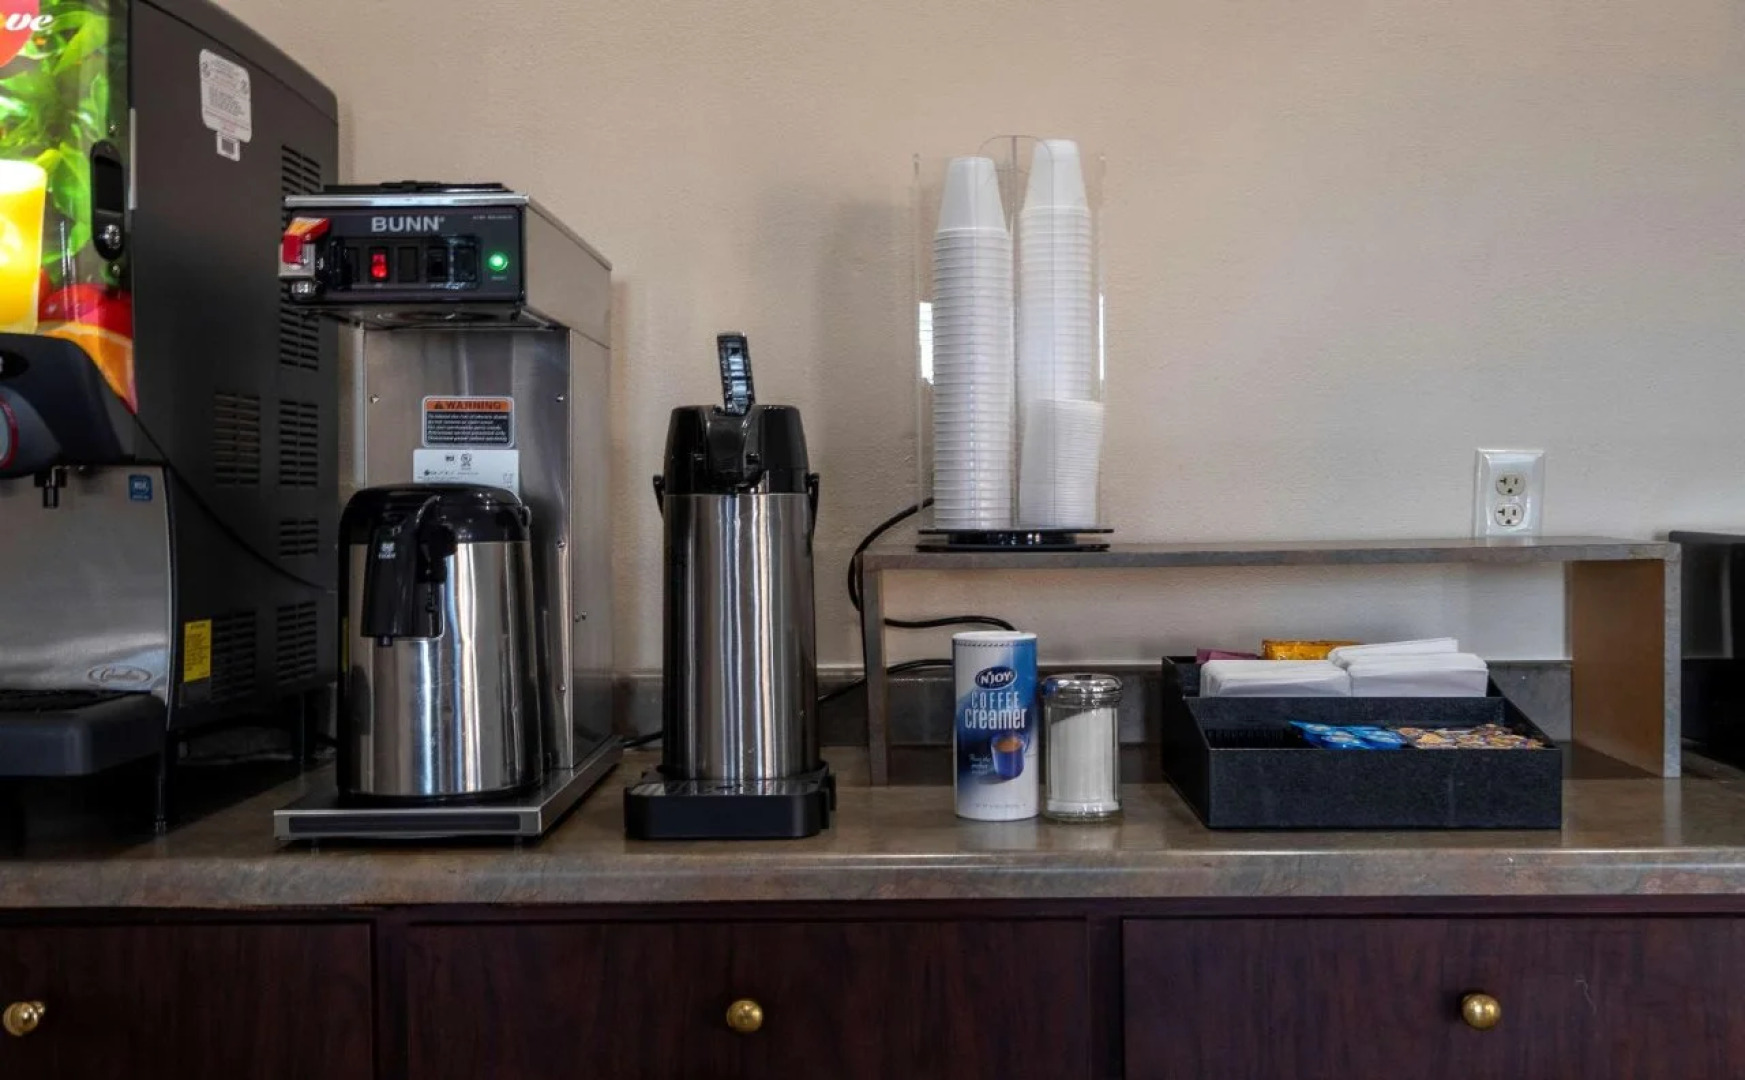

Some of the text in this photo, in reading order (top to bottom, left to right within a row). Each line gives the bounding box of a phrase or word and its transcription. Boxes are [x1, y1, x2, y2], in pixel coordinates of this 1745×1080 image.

[371, 216, 440, 232] BUNN
[446, 400, 502, 410] WARNING
[971, 691, 1020, 709] COFFEE
[964, 708, 1027, 730] creamer
